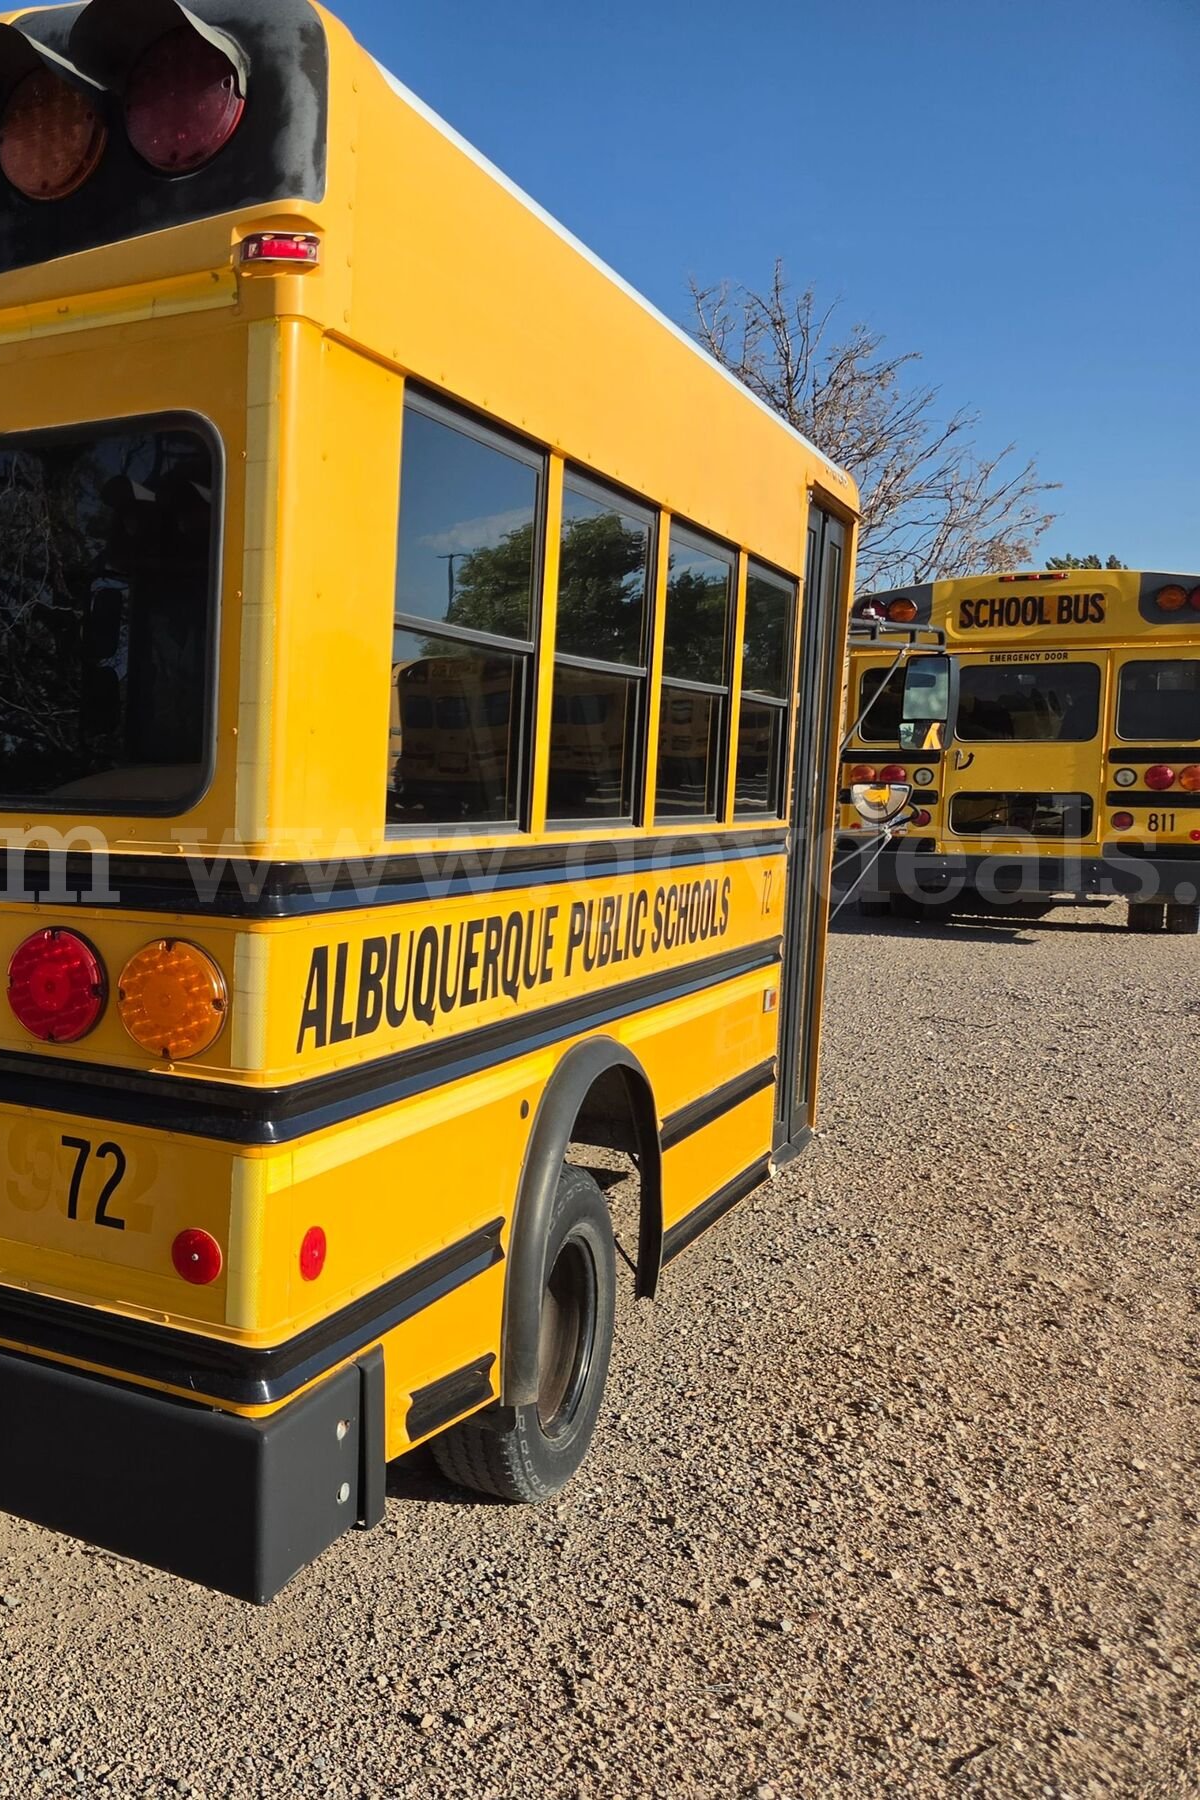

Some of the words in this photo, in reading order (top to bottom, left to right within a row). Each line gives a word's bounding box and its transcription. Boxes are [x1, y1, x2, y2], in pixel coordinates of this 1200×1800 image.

[958, 597, 1051, 630] SCHOOL
[1056, 592, 1107, 625] BUS
[989, 653, 1040, 663] EMERGENCY
[1044, 651, 1069, 662] DOOR
[1147, 813, 1176, 832] 811
[296, 905, 559, 1053] ALBUQUERQUE
[564, 889, 648, 978] PUBLIC
[651, 876, 732, 947] SCHOOLS
[61, 1135, 126, 1231] 72
